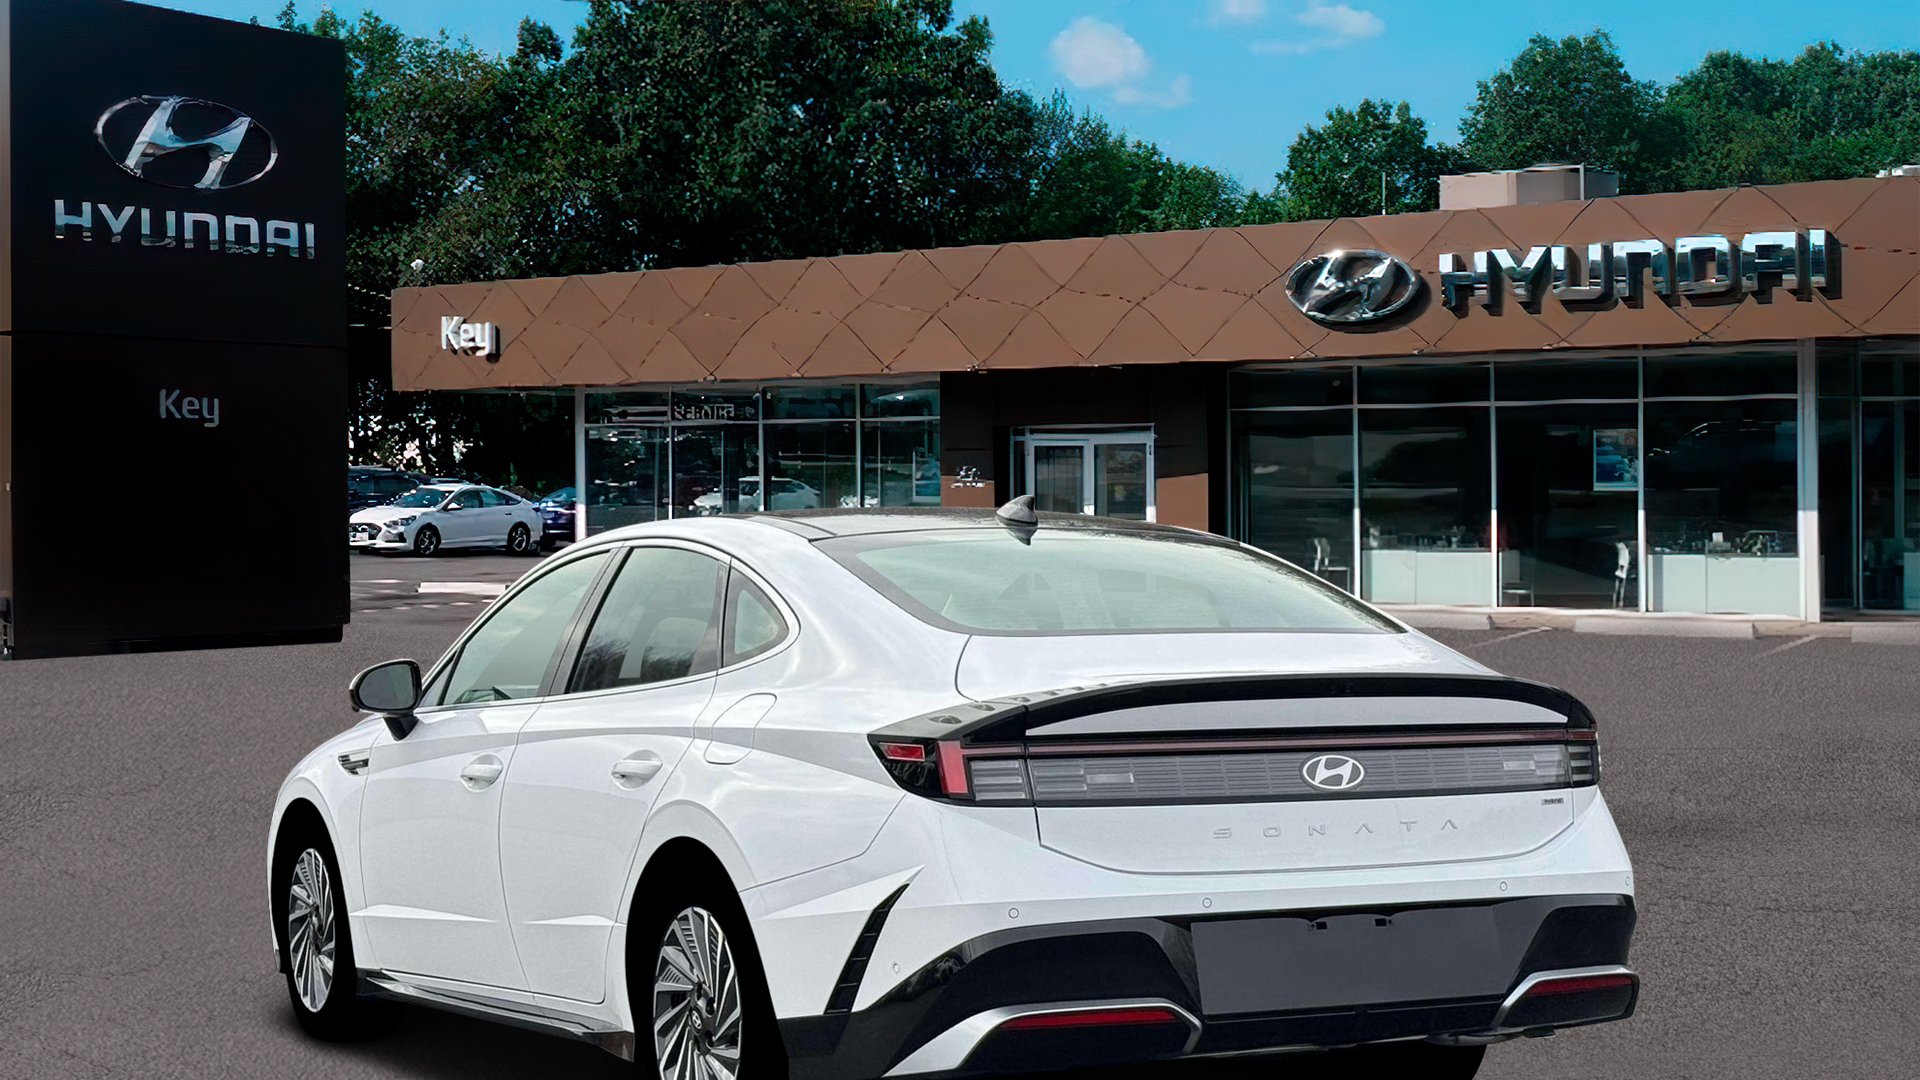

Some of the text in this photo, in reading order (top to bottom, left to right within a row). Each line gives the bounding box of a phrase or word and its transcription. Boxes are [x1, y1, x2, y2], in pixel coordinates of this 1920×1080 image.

[54, 198, 315, 259] HYUNDAI
[1438, 228, 1842, 317] HYUNDAI
[441, 315, 495, 357] Key
[158, 388, 220, 428] Key
[1212, 818, 1459, 840] SONATA
